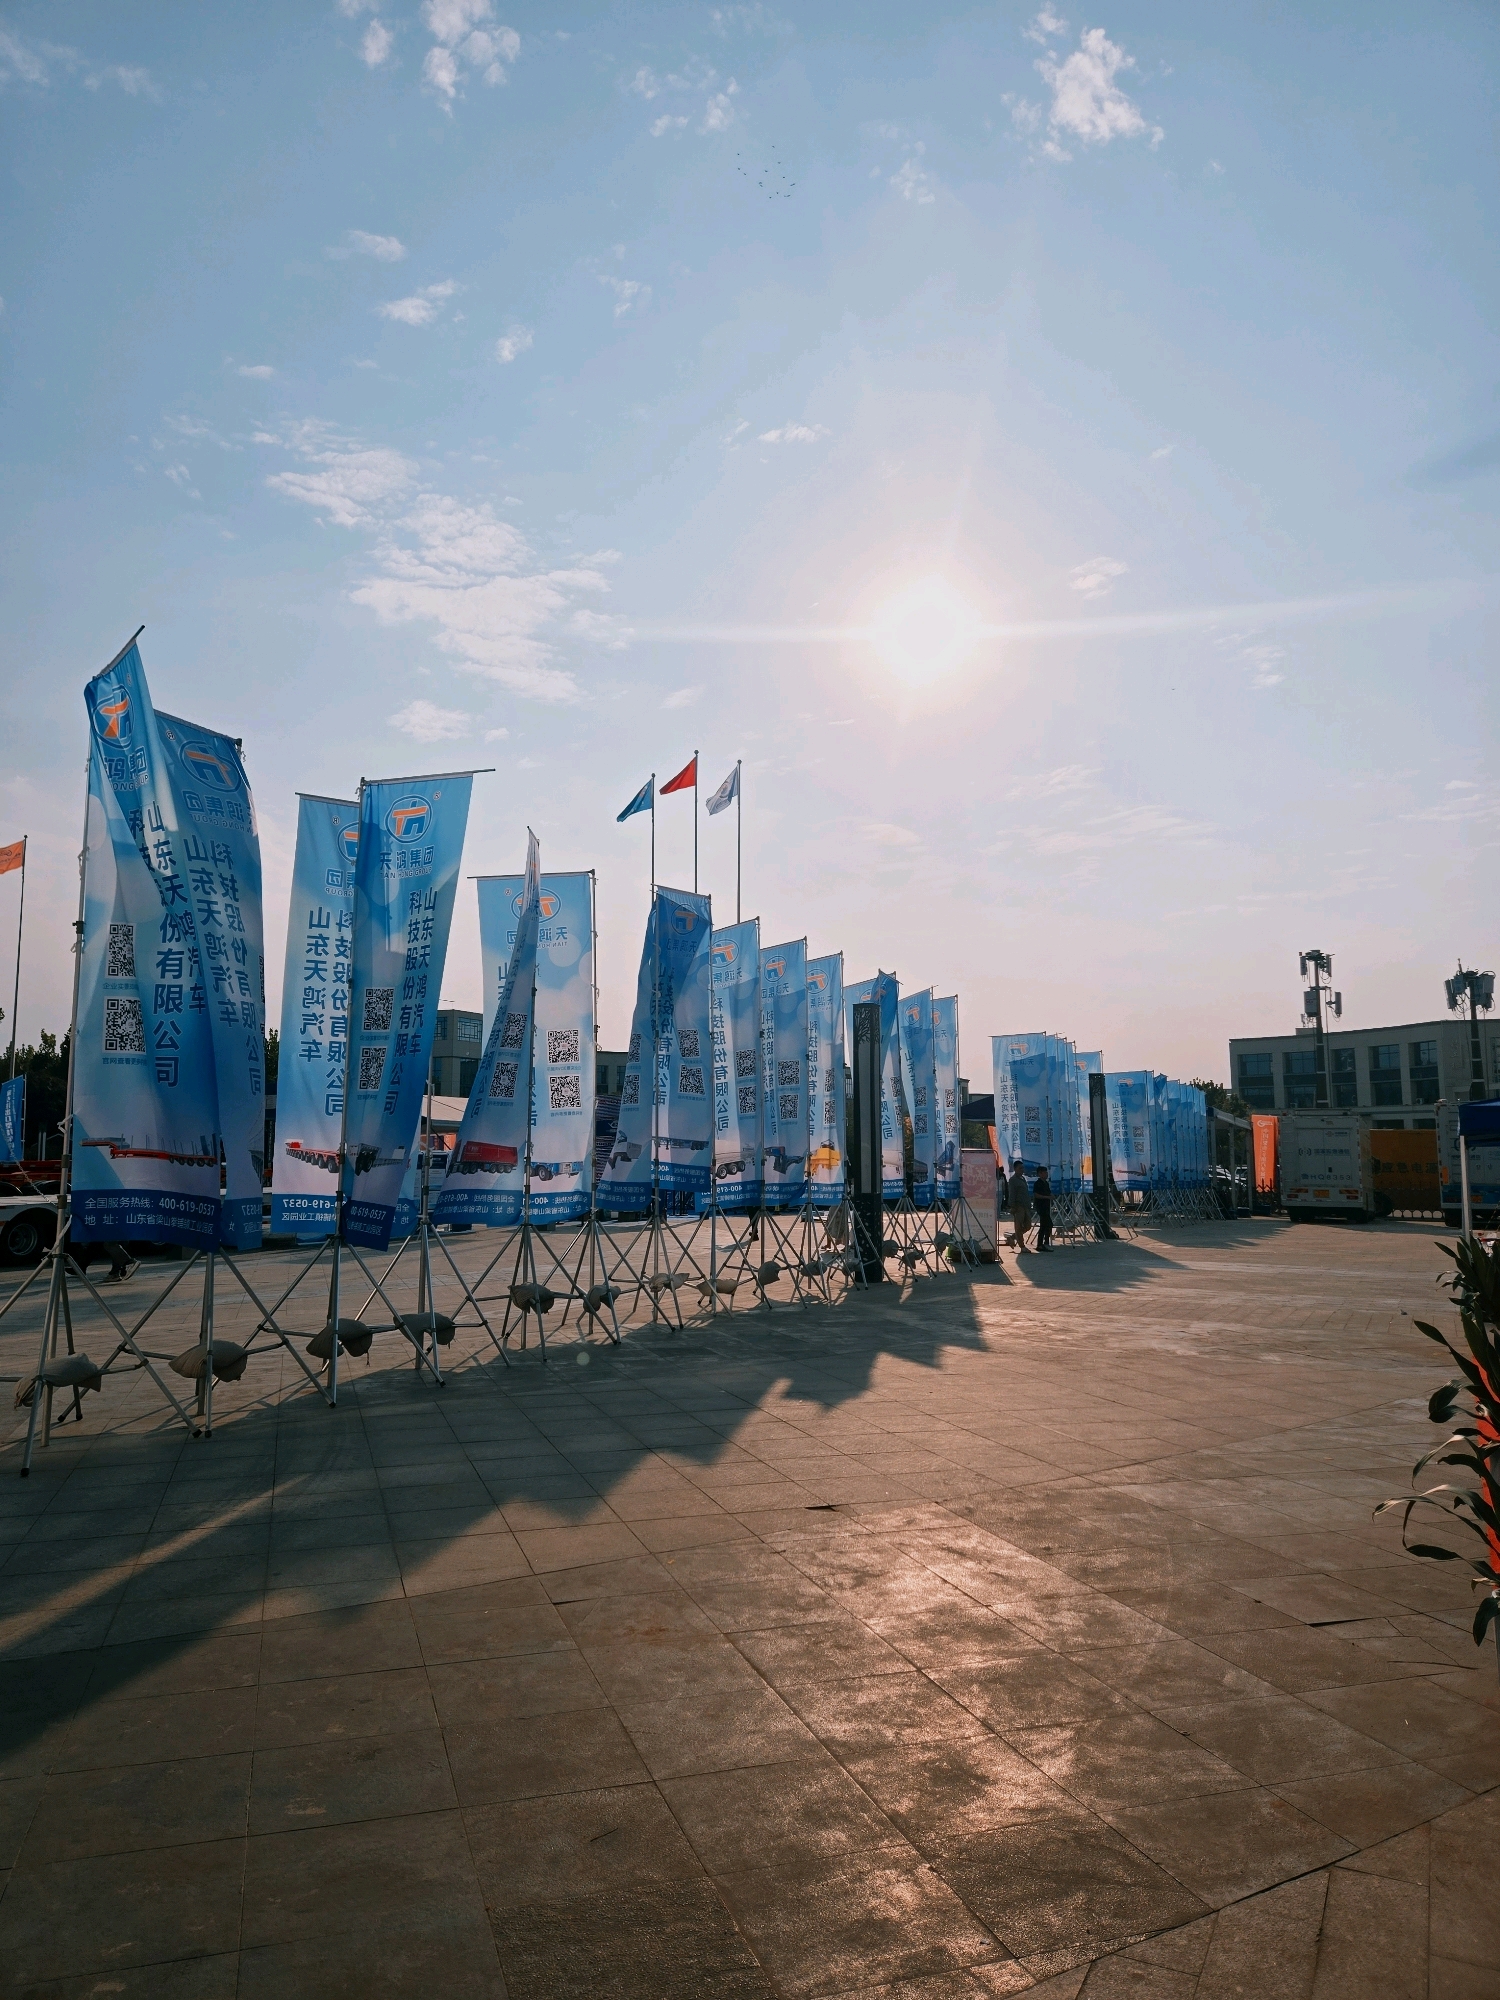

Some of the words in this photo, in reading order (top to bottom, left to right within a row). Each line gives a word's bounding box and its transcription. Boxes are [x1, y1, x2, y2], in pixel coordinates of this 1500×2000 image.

[379, 845, 434, 871] 天鸿集团
[384, 890, 421, 1115] 科技股份有限公司
[409, 887, 437, 1057] 山东天鸿汽车
